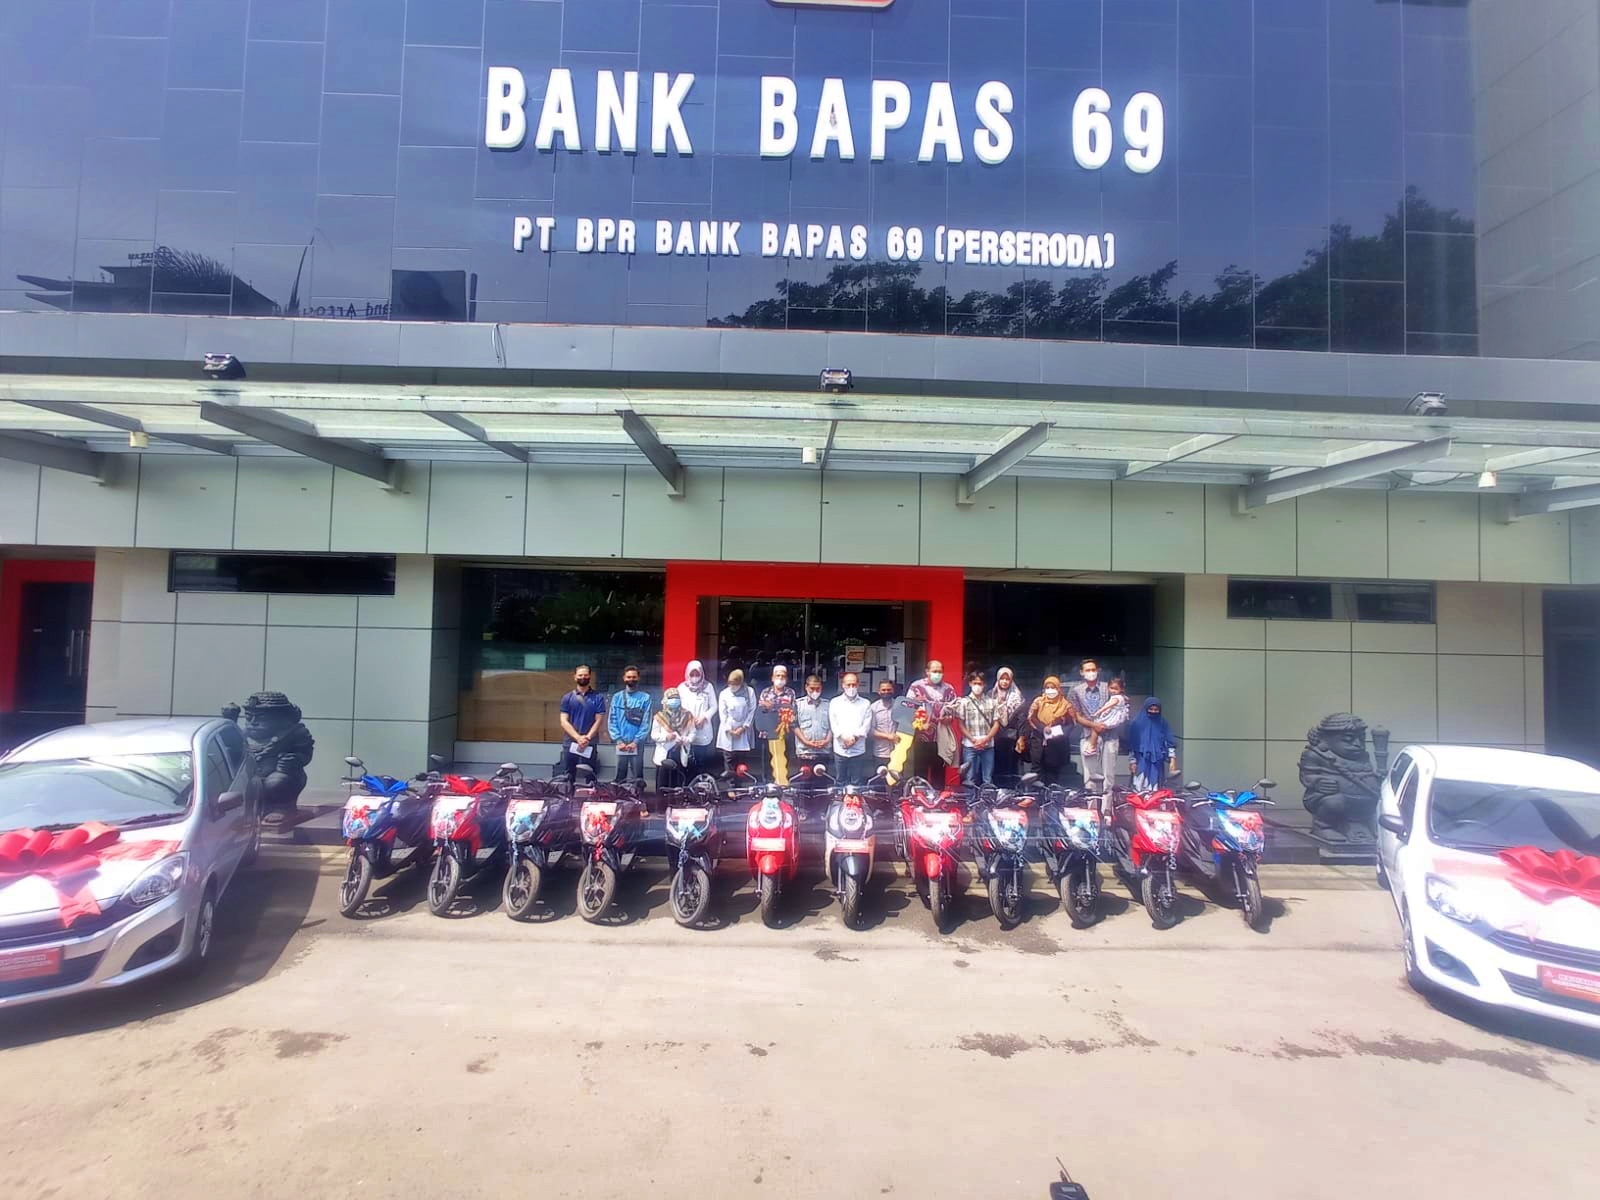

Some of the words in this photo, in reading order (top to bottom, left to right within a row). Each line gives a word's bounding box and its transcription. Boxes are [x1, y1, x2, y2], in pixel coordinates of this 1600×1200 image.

[484, 66, 695, 155] BANK
[759, 76, 1014, 165] BAPAS
[1071, 86, 1165, 174] 69
[513, 215, 556, 252] PT
[576, 217, 637, 254] BPR
[655, 219, 742, 256] BANK
[761, 222, 868, 260] BAPAS
[886, 226, 923, 262] 69
[934, 226, 1116, 269] (PERSERODA)
